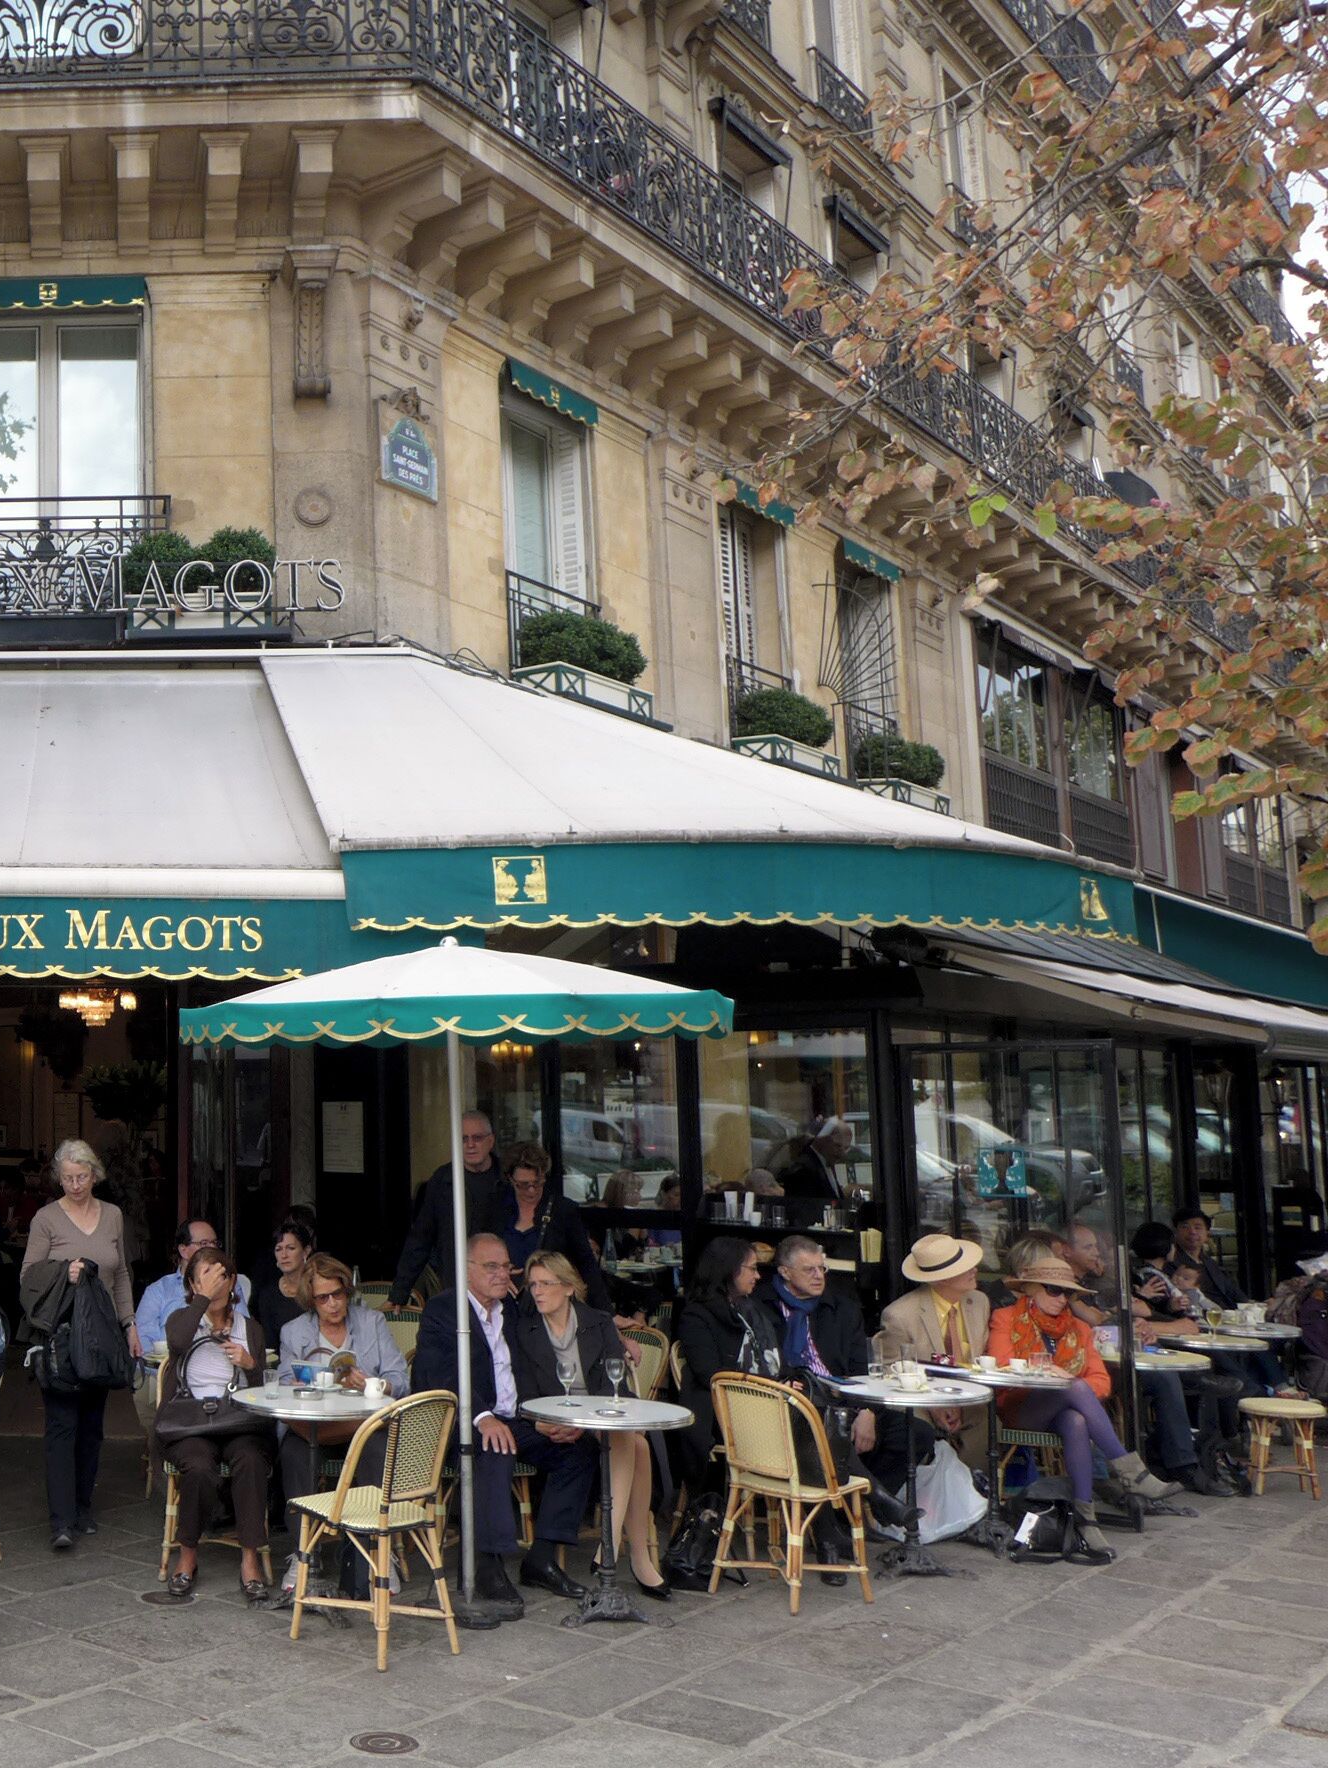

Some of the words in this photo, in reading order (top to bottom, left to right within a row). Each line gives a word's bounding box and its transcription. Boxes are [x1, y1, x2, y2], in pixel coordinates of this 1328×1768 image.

[401, 445, 419, 460] PLACE
[398, 468, 409, 480] DES
[64, 554, 347, 614] MAGOTS
[65, 909, 263, 953] MAGOTS
